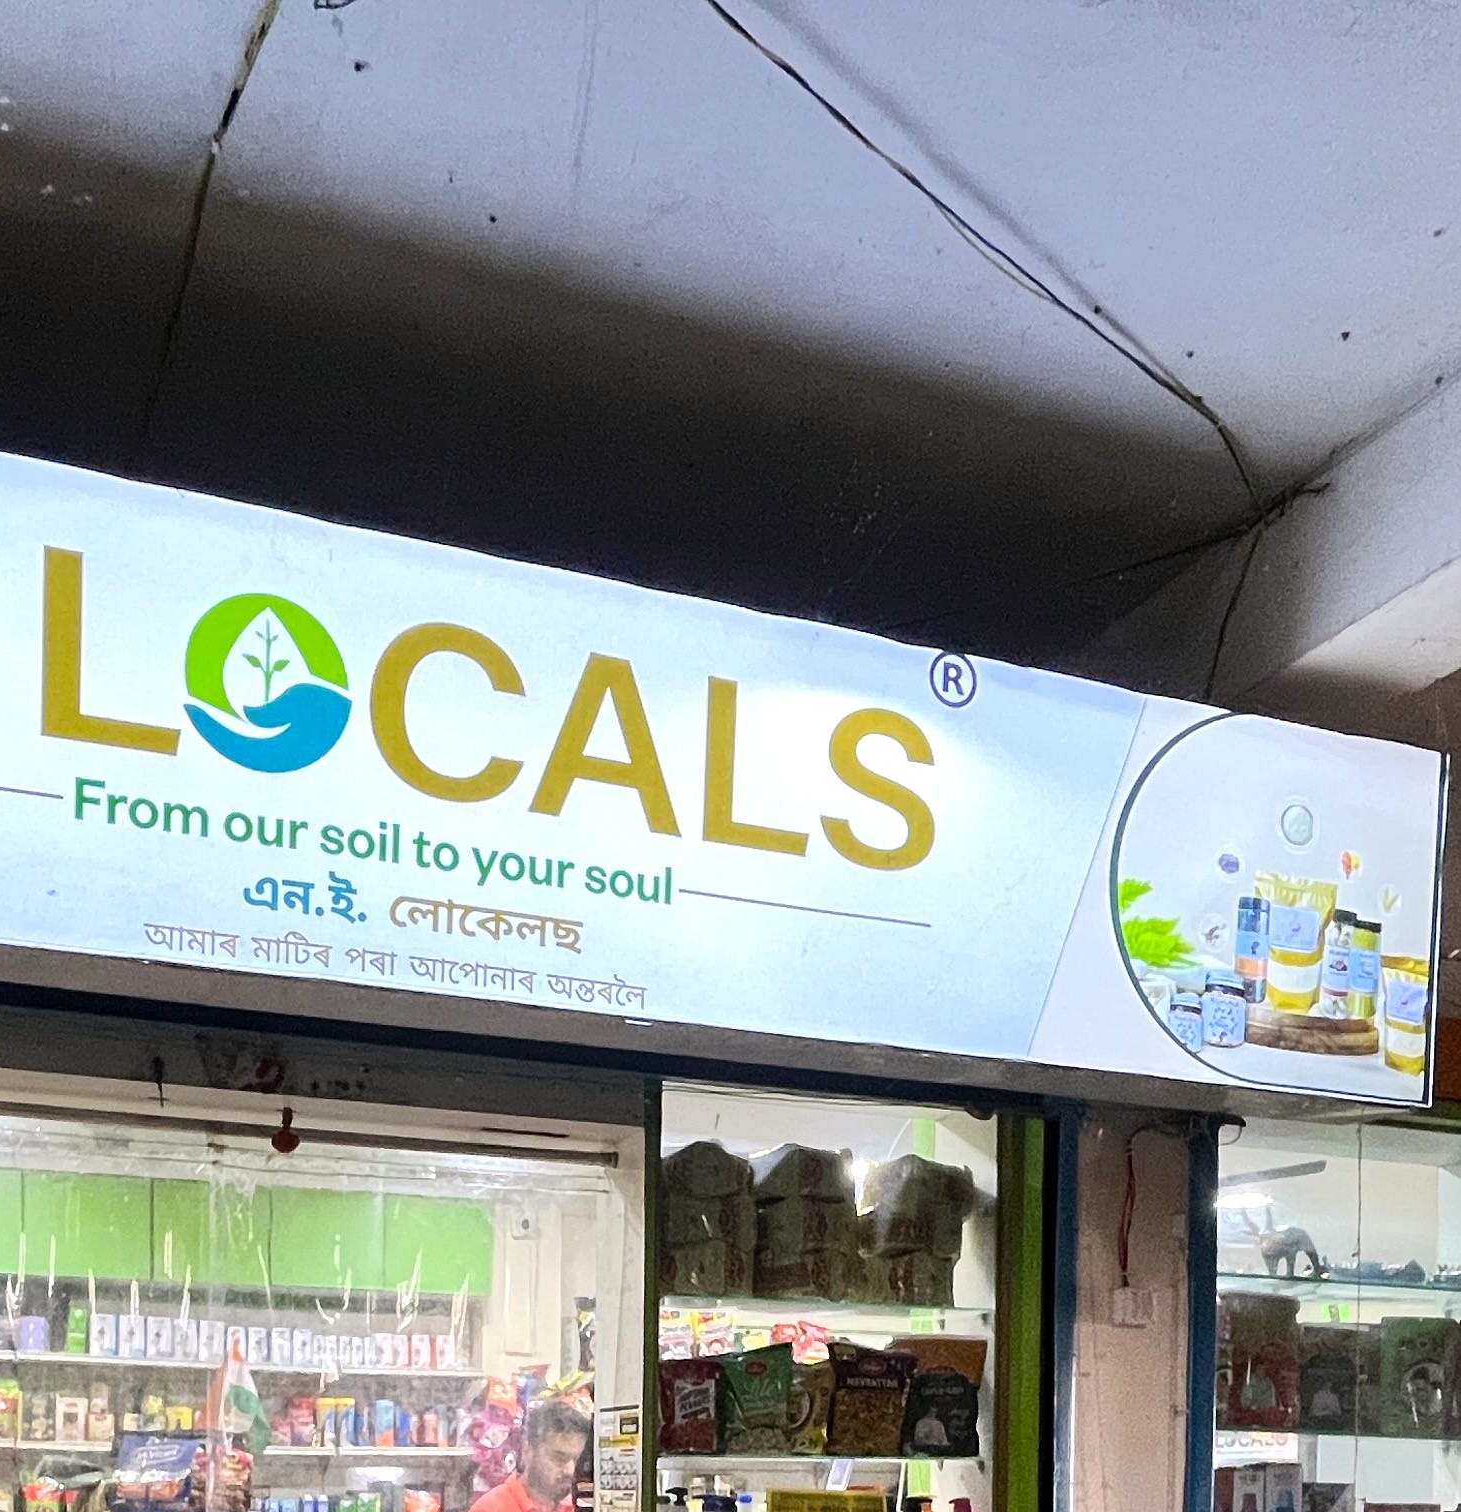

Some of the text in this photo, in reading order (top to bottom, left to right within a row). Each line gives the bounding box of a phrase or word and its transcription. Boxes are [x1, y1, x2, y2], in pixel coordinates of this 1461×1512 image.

[40, 544, 936, 871] LOCALS
[74, 777, 672, 904] From our soil to your soul
[143, 922, 240, 958] আমাৰ
[251, 930, 333, 968] মাটিৰ
[345, 946, 398, 977] পৰা
[409, 955, 538, 994] আপোনাৰ
[243, 871, 584, 954] এন.ই. লোকেলছ
